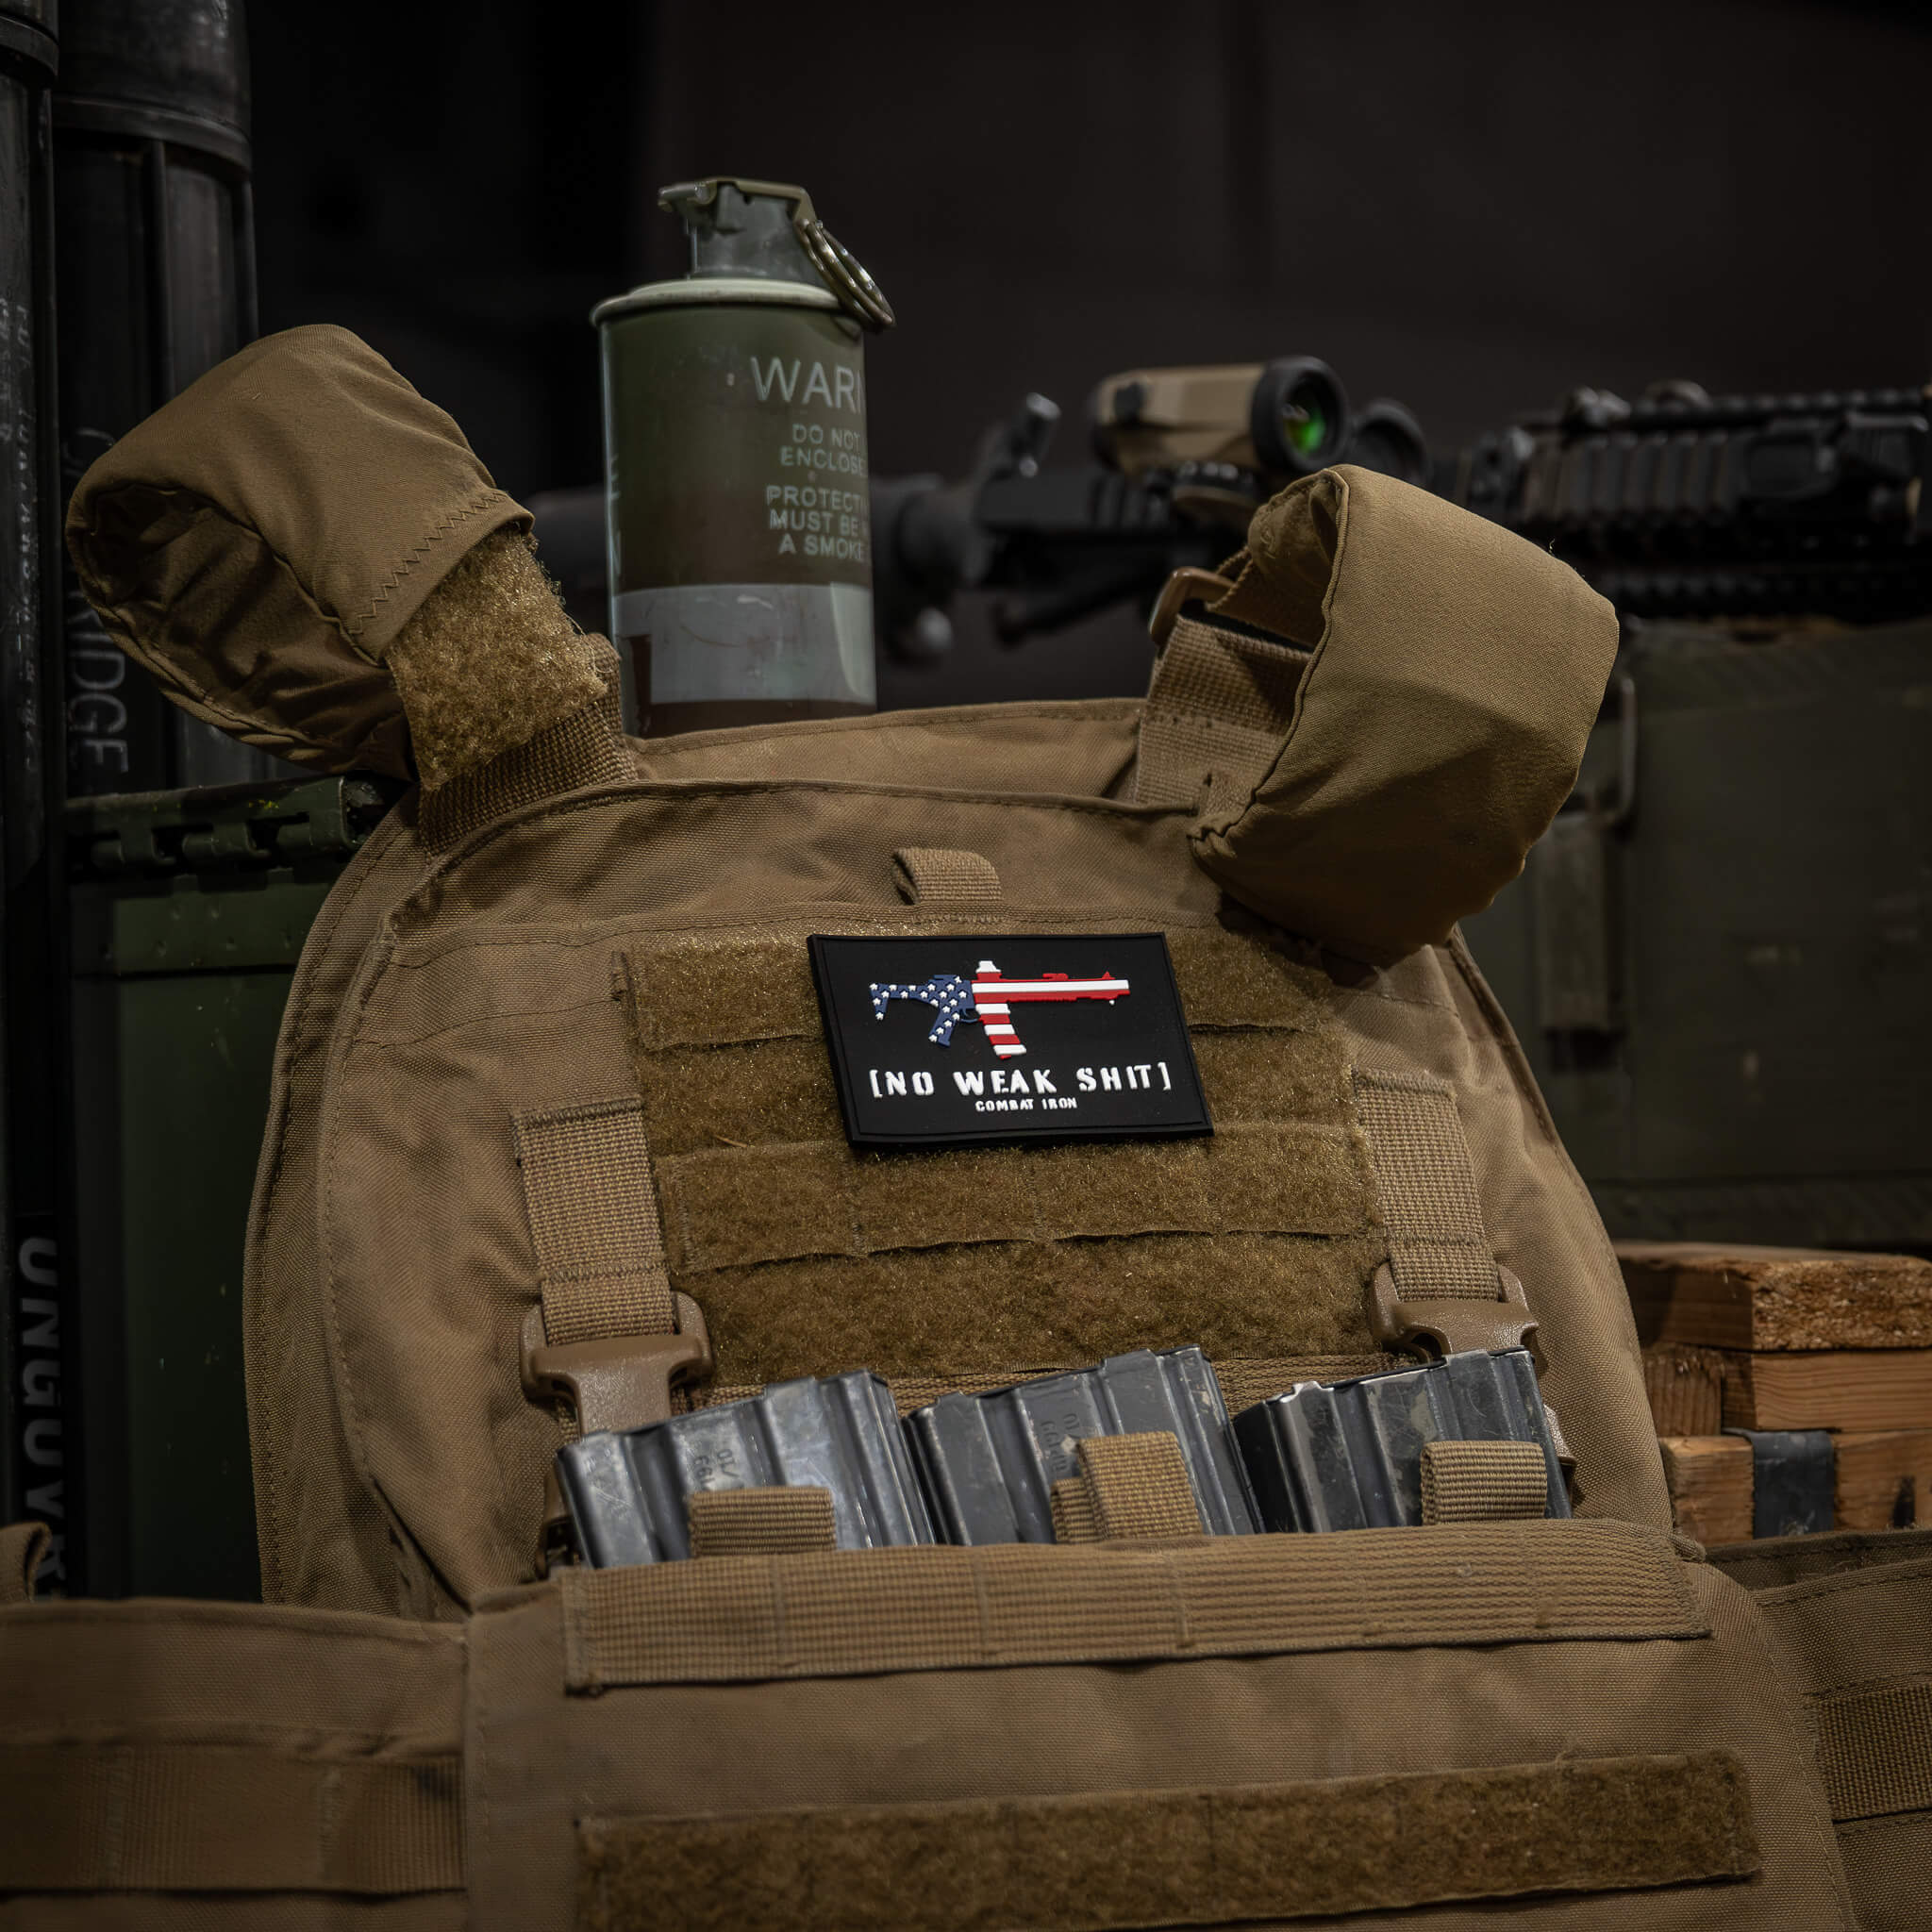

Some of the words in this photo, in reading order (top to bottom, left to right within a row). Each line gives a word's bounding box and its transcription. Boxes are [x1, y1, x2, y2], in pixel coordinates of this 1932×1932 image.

[792, 424, 824, 444] DO
[831, 428, 861, 452] NOT
[770, 508, 833, 534] MUST
[779, 533, 796, 555] A
[953, 1069, 1058, 1096] WEAK
[974, 1098, 1034, 1112] COMBAT
[1041, 1097, 1077, 1110] IRON
